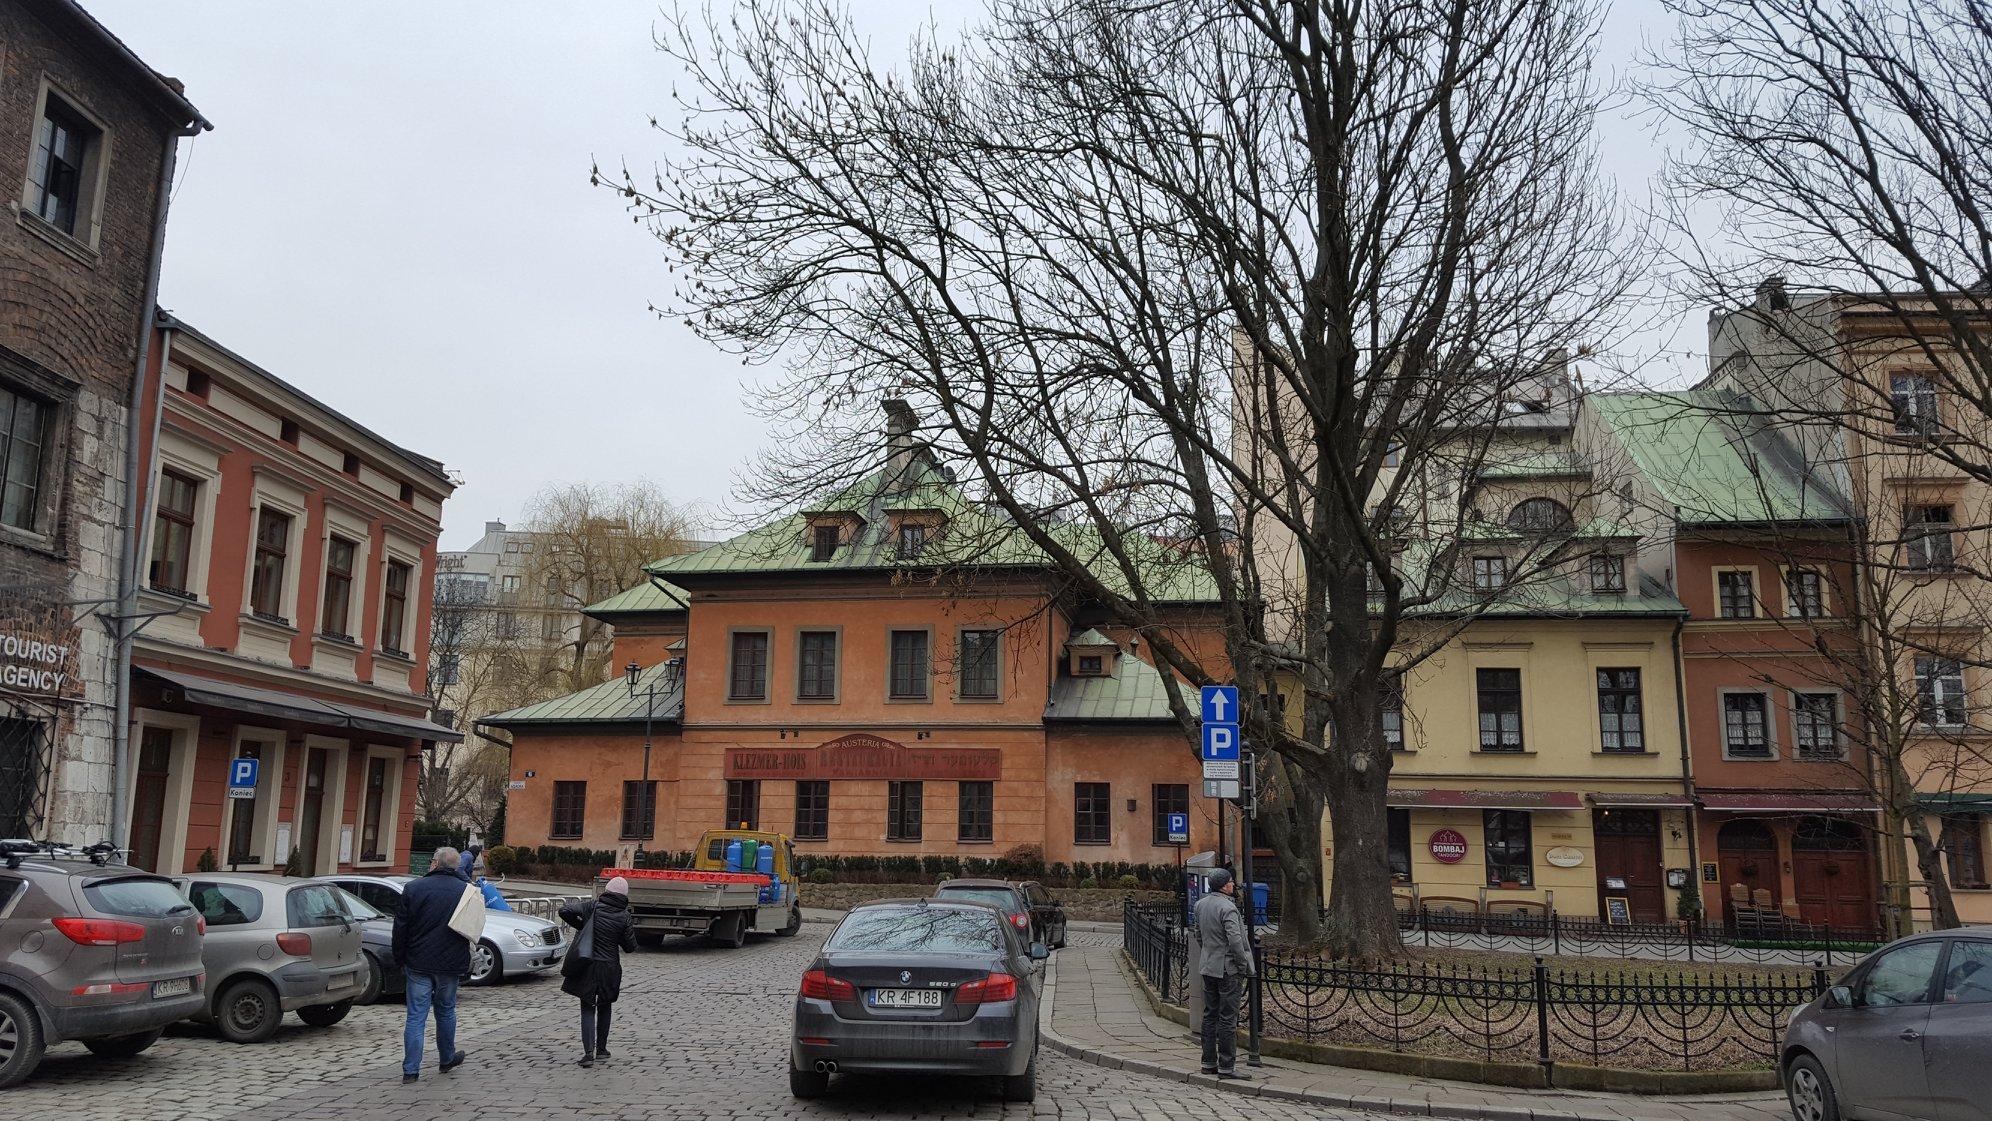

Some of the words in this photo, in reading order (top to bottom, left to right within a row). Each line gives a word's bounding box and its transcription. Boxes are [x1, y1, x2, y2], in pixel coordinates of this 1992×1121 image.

[0, 664, 65, 691] GENCY
[841, 737, 881, 749] AUSTERIA
[1211, 727, 1232, 756] P
[733, 753, 806, 770] KLEZMER-HOIS
[236, 762, 252, 783] P
[230, 789, 253, 797] Koniec
[1172, 816, 1183, 831] P
[1433, 845, 1465, 854] BOMBAJ
[877, 990, 896, 1004] KR
[900, 990, 939, 1005] 4F188
